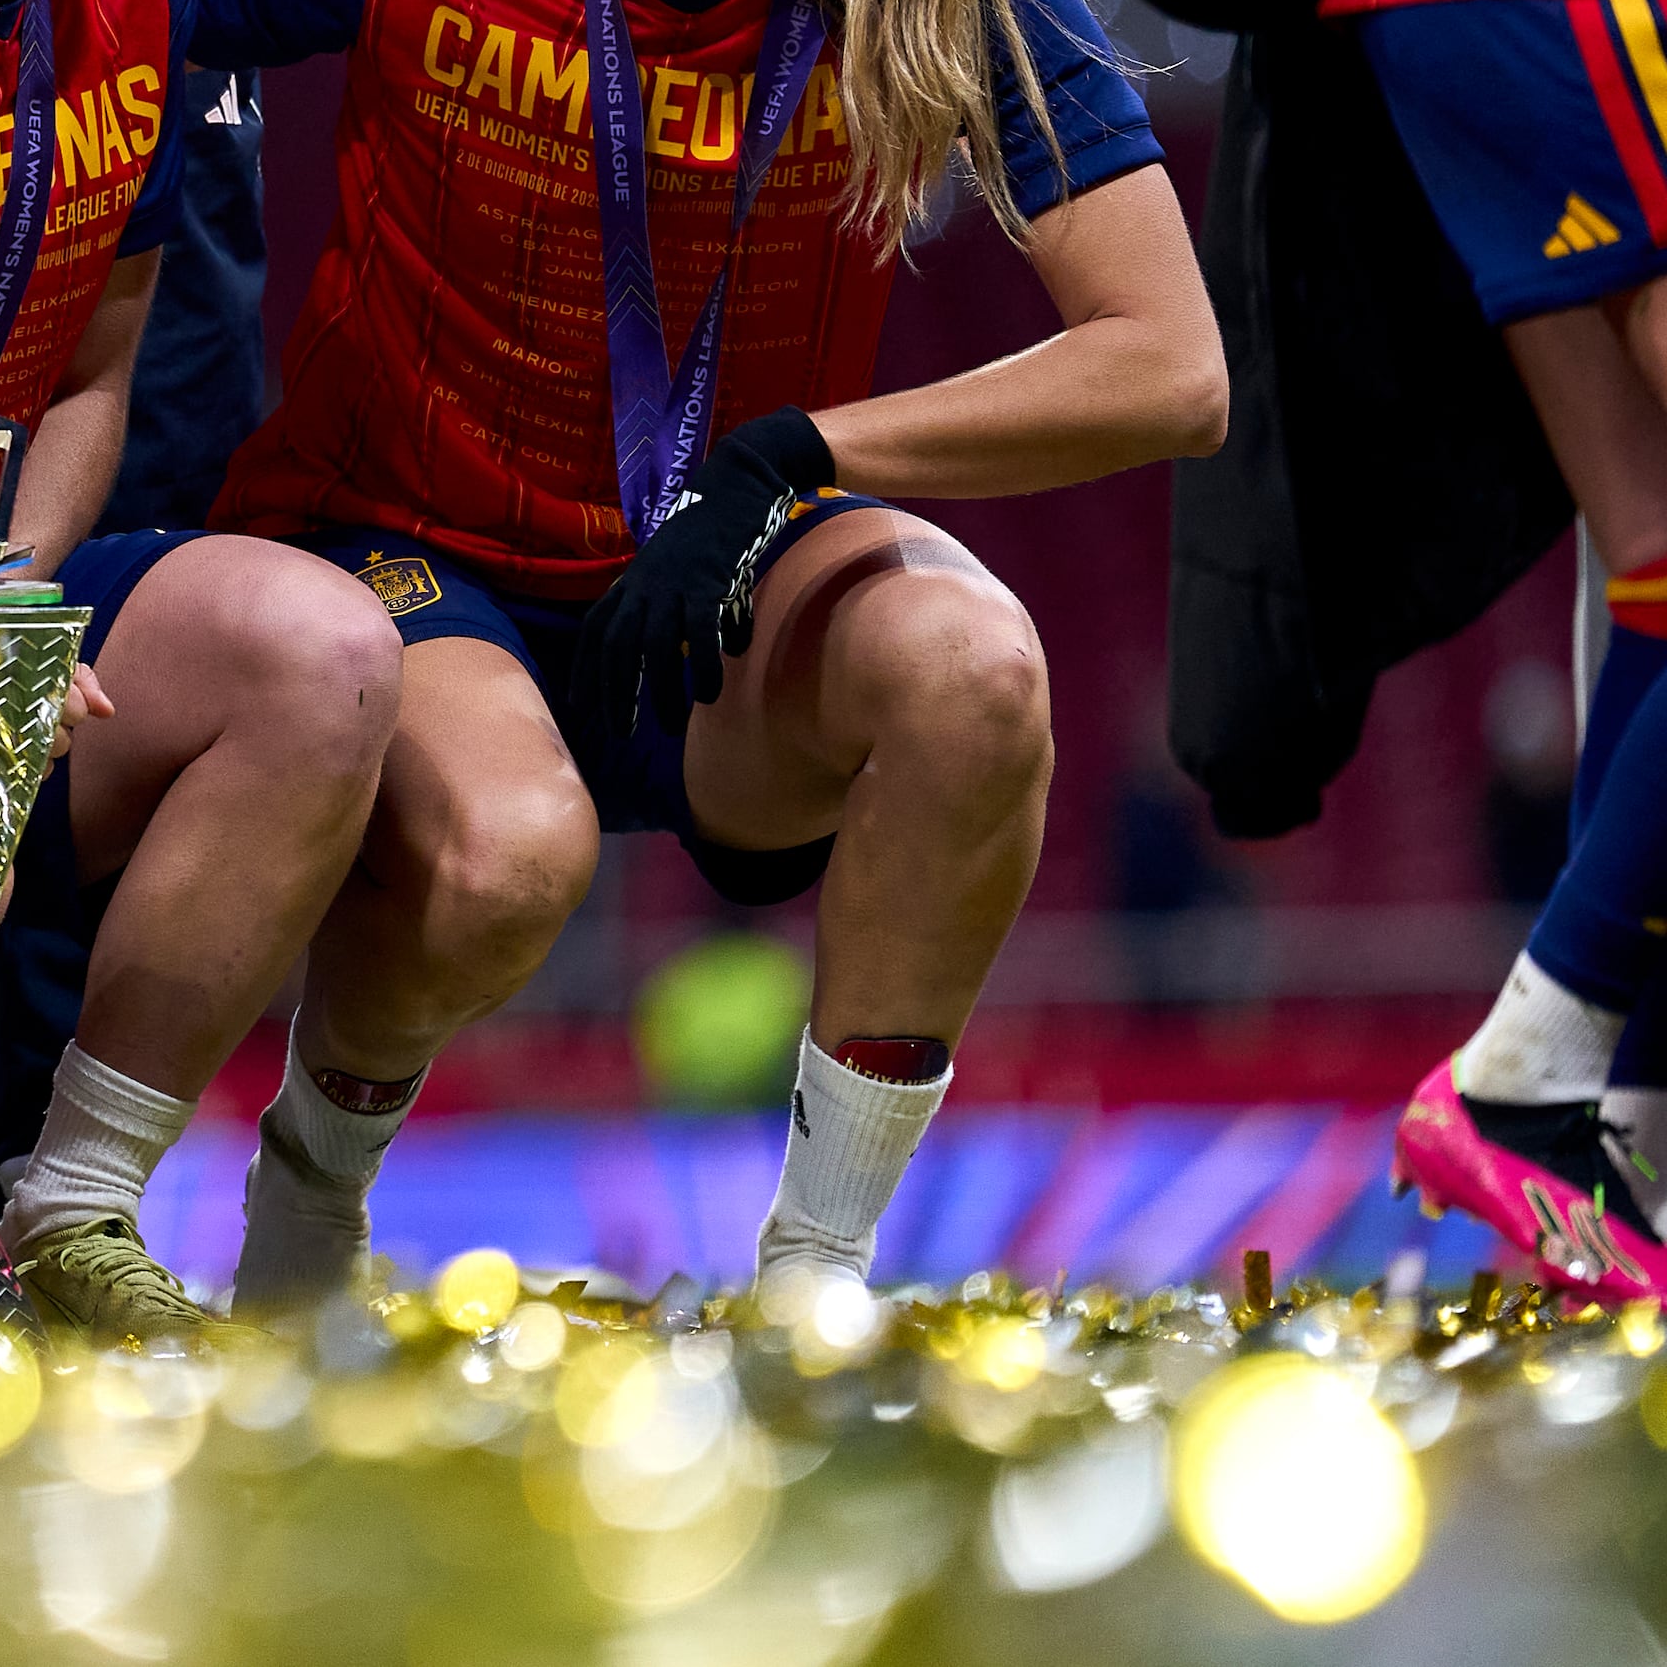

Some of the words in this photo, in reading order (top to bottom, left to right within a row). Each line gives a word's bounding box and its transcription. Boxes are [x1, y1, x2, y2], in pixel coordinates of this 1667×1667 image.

[27, 98, 44, 156] UEFA
[758, 82, 789, 137] UEFA
[414, 88, 470, 132] UEFA
[478, 118, 590, 173] WOMEN'S
[710, 162, 805, 192] LEGUE
[609, 109, 630, 203] LEAGUE
[456, 148, 465, 164] 2
[467, 150, 483, 169] DE
[484, 155, 551, 197] DICIEMBRE
[551, 181, 568, 202] DE
[4, 157, 42, 268] WOMEN'S
[44, 196, 109, 236] LEAGUE
[476, 202, 599, 242] ASTRALAG
[482, 279, 605, 324] M.MENDEZ
[8, 320, 54, 340] EILA
[491, 337, 595, 383] MARIONA
[504, 405, 585, 438] ALEXIA
[670, 365, 708, 471] NATIONS
[459, 421, 513, 451] CATA
[520, 445, 578, 473] COLL
